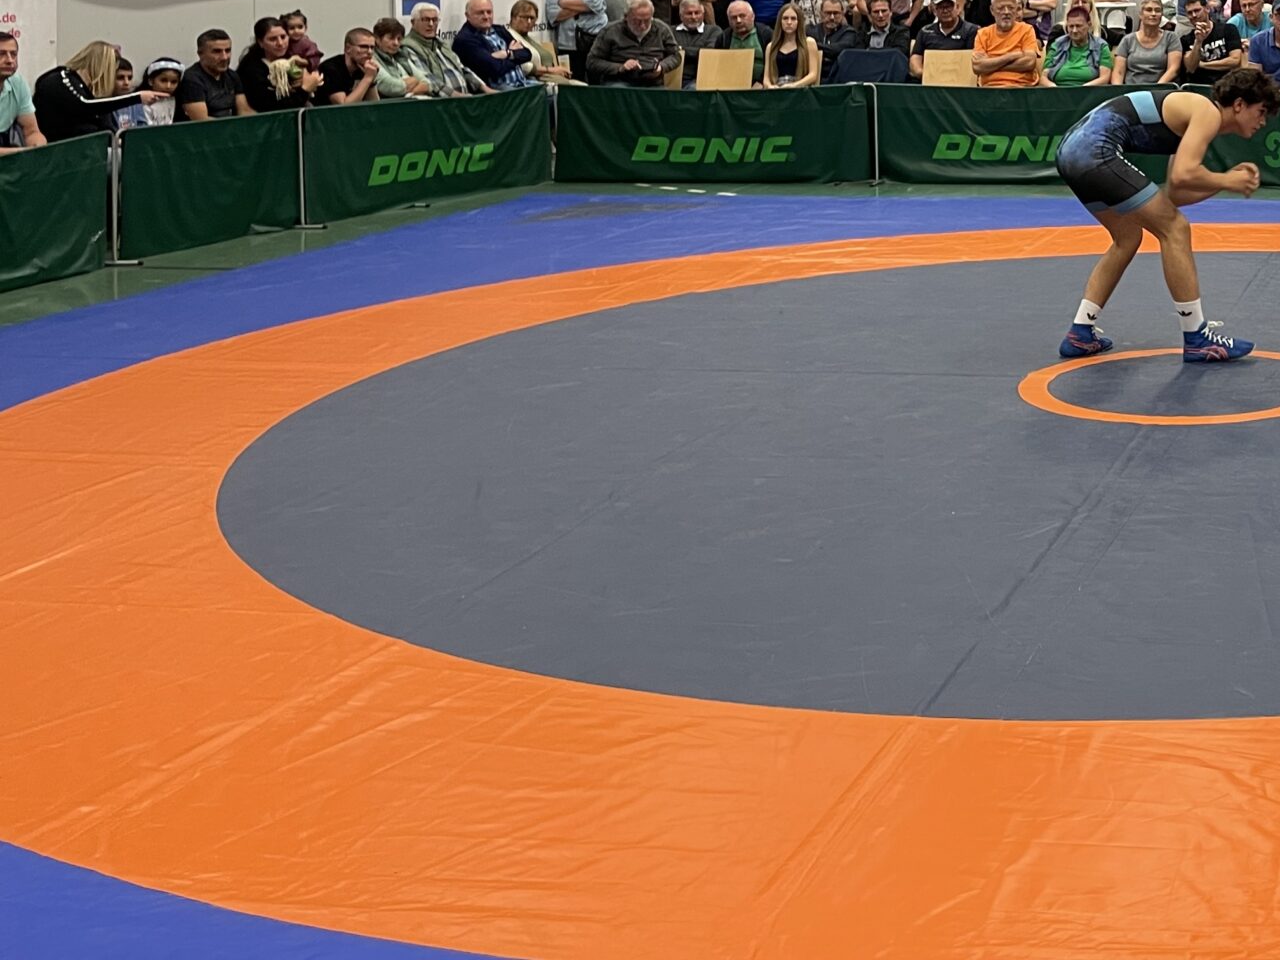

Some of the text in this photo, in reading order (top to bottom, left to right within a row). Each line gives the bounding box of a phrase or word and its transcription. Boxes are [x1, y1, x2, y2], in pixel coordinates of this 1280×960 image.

[631, 136, 793, 163] DONIC
[932, 134, 1067, 162] DONI
[368, 143, 495, 187] DONIC
